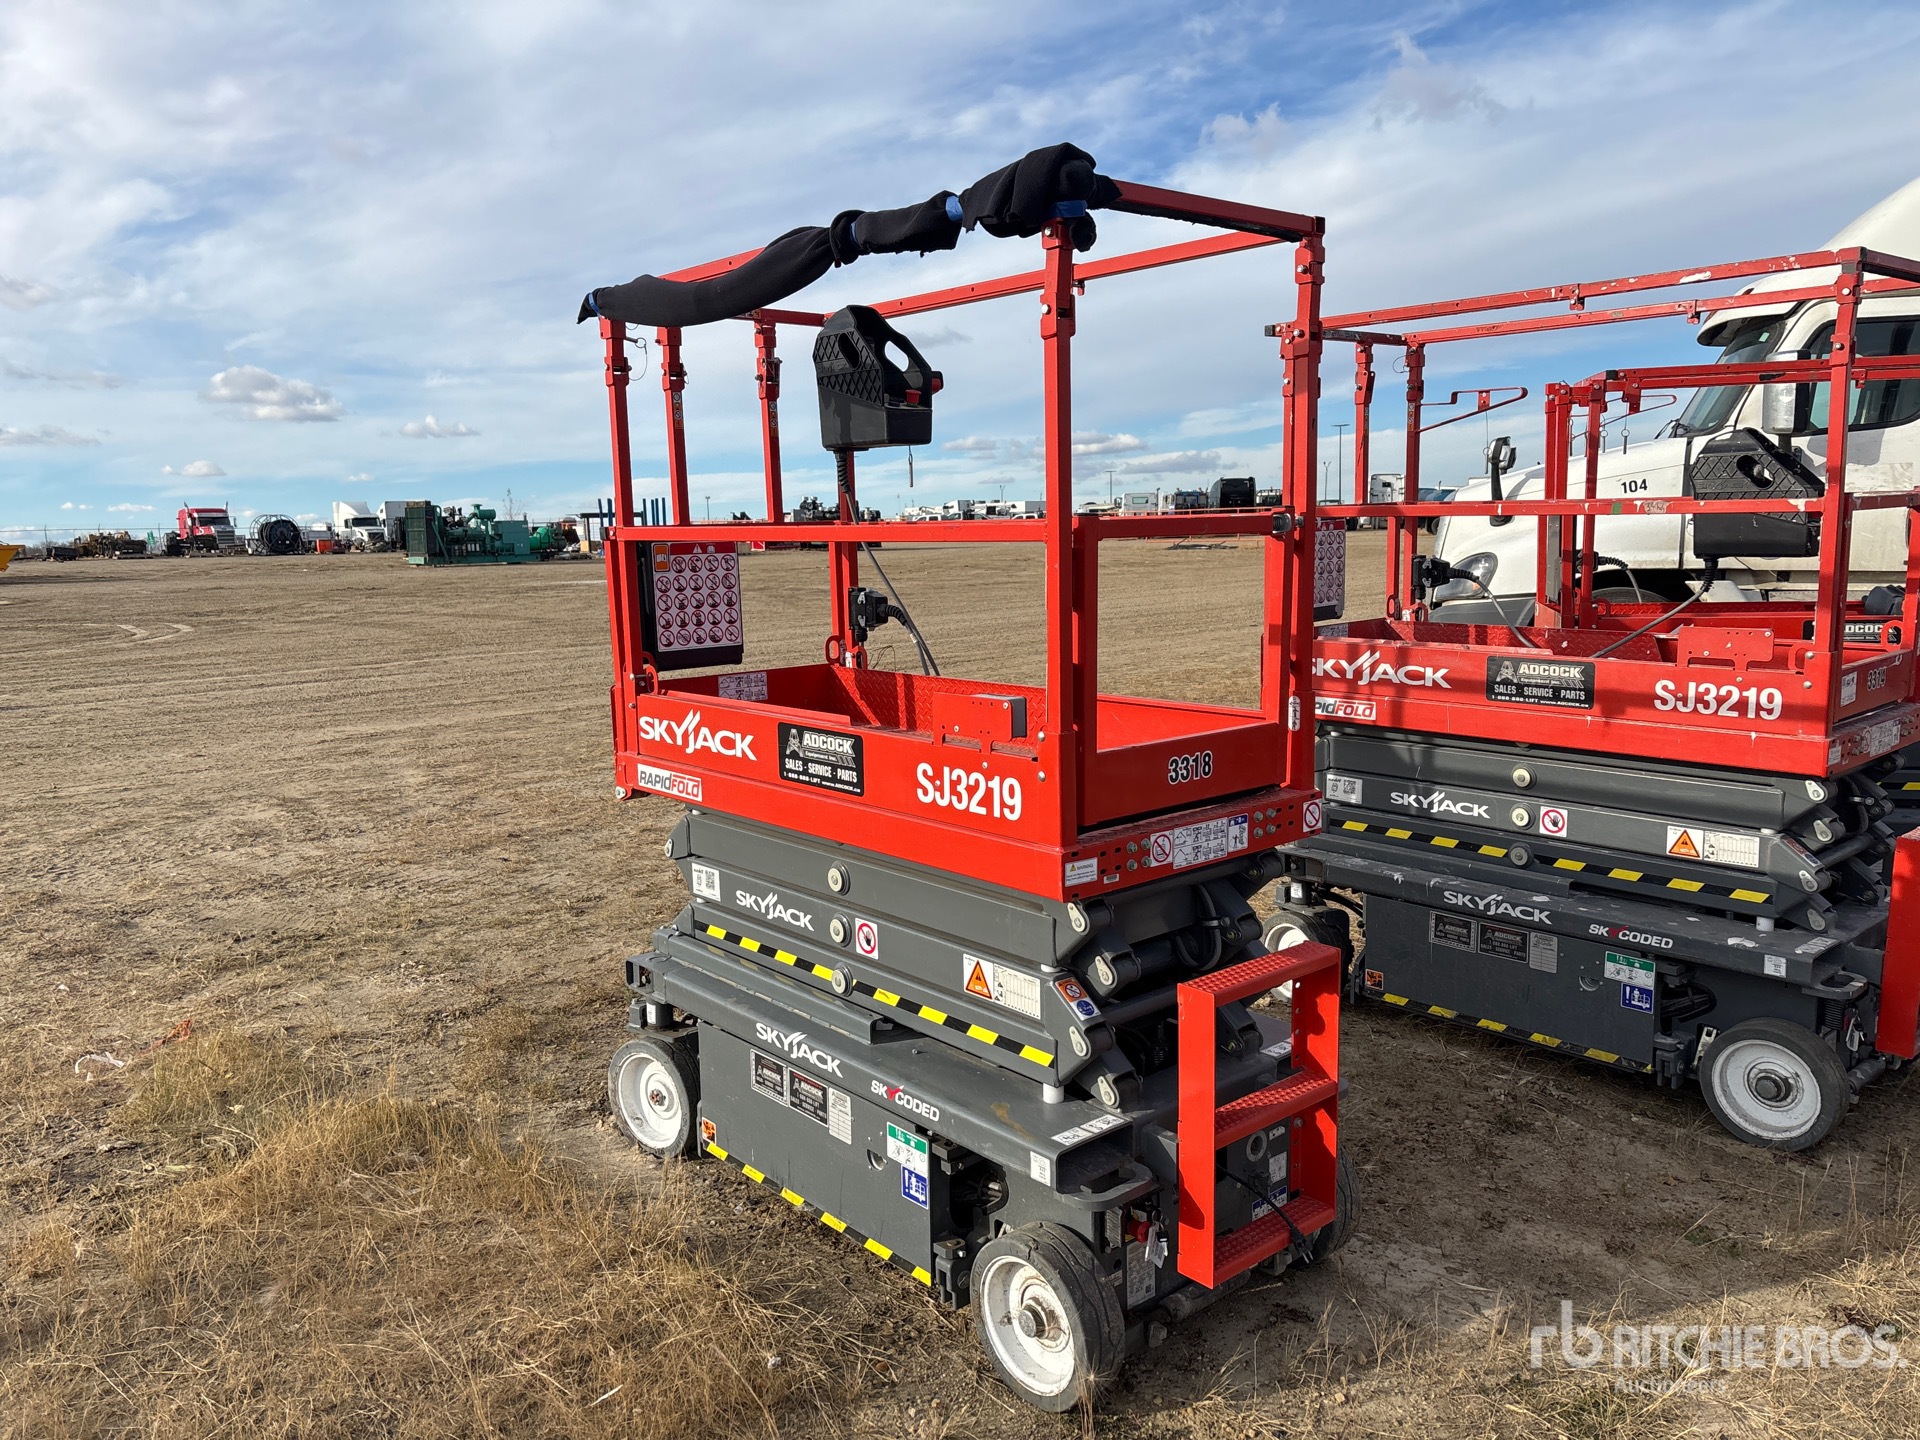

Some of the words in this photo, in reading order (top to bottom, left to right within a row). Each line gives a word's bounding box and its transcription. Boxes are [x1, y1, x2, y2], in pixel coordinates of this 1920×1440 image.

[1620, 478, 1648, 494] 104
[1519, 663, 1582, 678] ADCOCK
[1494, 684, 1516, 694] SALES
[1524, 686, 1553, 698] SERVICE
[1561, 689, 1585, 700] PARTS
[1654, 679, 1783, 720] SJ3219
[639, 708, 758, 761] SKYJACK
[803, 732, 853, 754] ADCOCK
[784, 757, 803, 771] SALES
[807, 762, 832, 778] SERVICE
[837, 768, 857, 783] PARTS
[1167, 749, 1213, 785] 3318
[916, 762, 1022, 822] SJ3219
[1390, 790, 1491, 819] SKYJACK
[735, 891, 815, 932] SKYJACK
[1443, 890, 1553, 925] SKYJACK
[1588, 923, 1674, 949] SKYCODED
[756, 1022, 844, 1079] SKYJACK
[870, 1079, 940, 1122] SKYCODED
